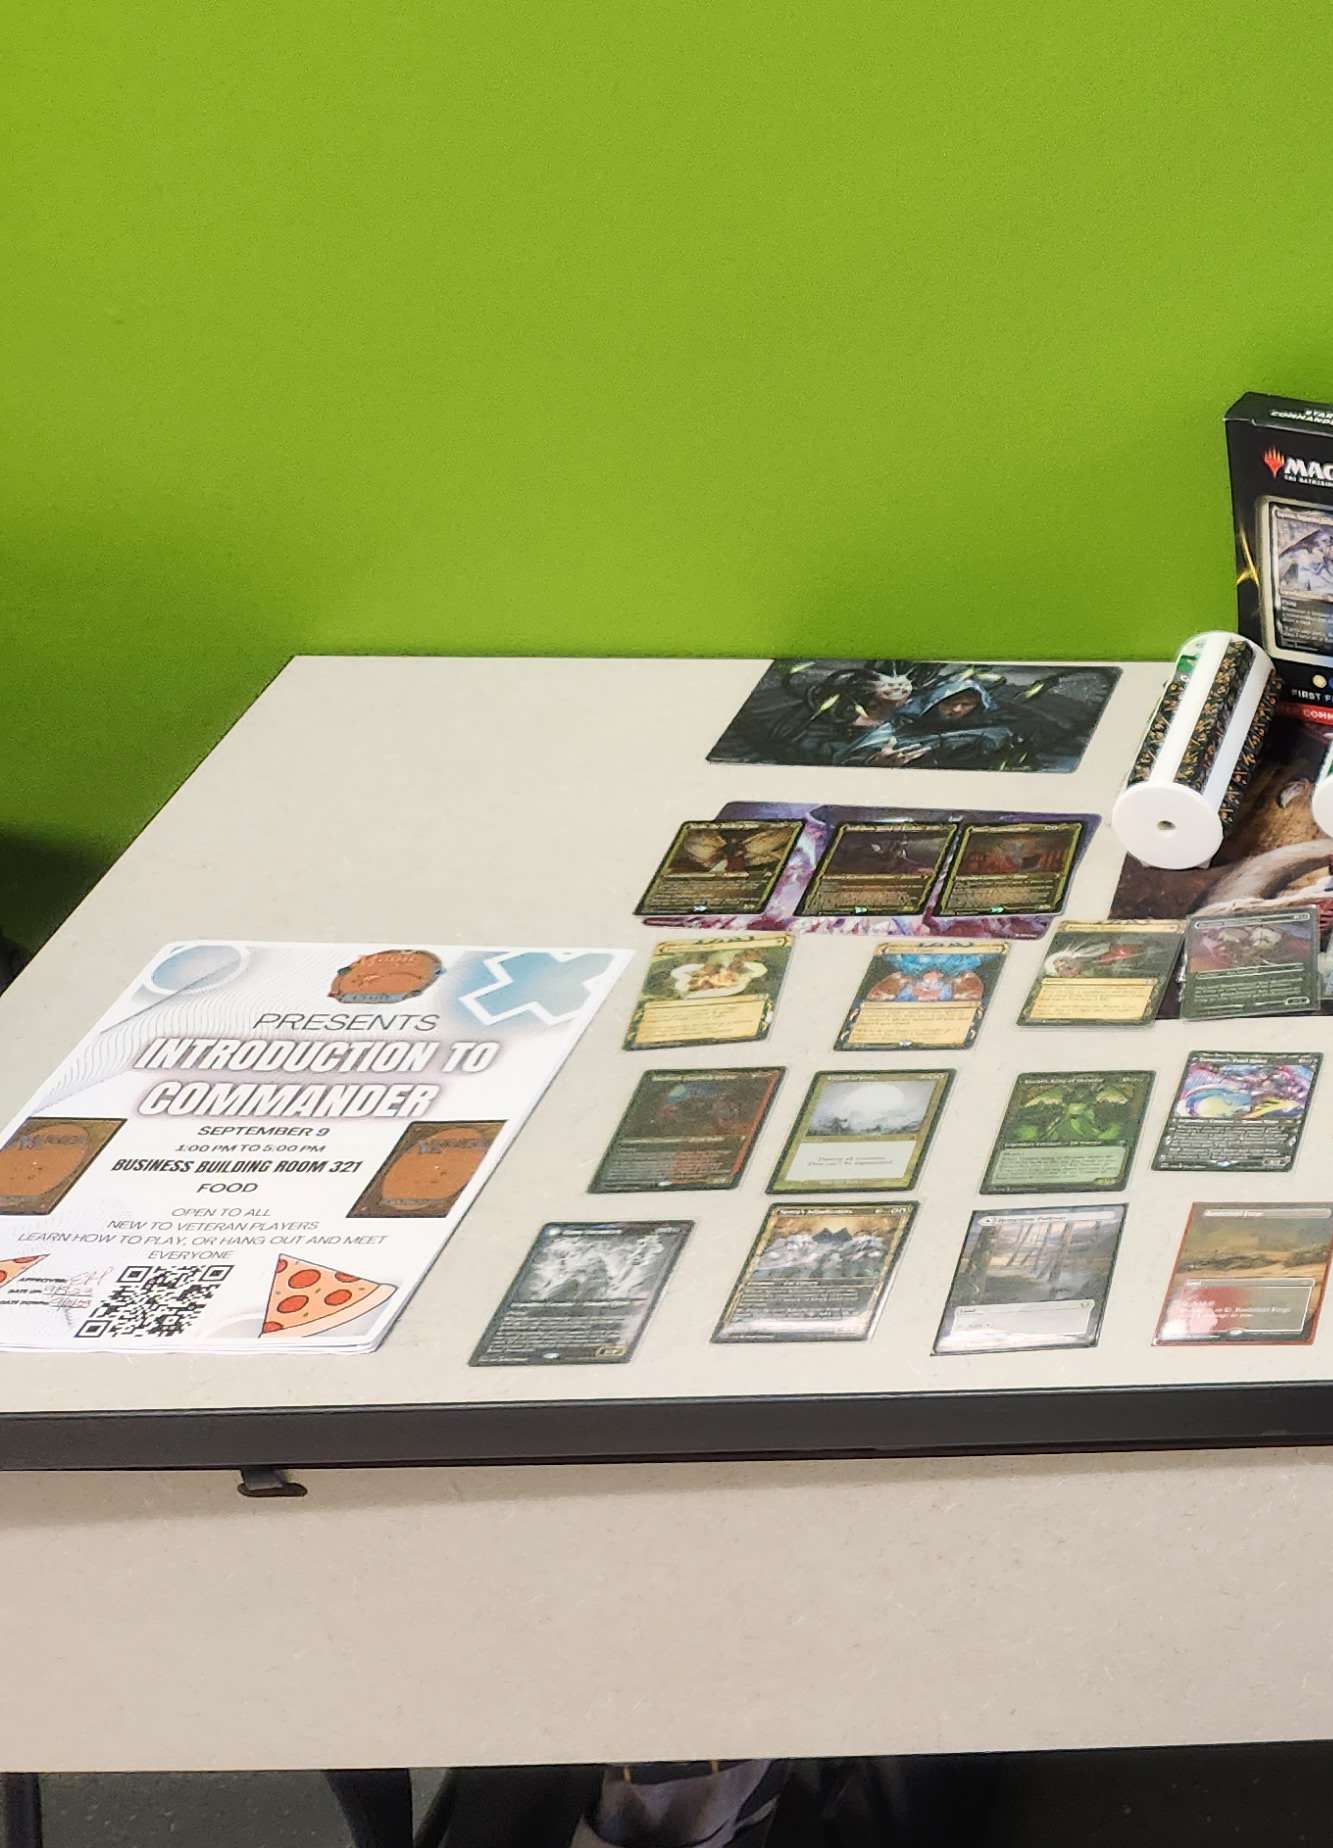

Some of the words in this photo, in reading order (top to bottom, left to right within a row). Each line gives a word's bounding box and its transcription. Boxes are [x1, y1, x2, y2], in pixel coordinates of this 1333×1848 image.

[1291, 688, 1322, 700] FIRST
[253, 1013, 441, 1032] PRESENTS
[133, 1036, 441, 1074] INTRODUCTION
[442, 1041, 503, 1074] TO
[136, 1080, 443, 1119] COMMANDER
[197, 1125, 311, 1137] SEPTEMBER
[315, 1127, 331, 1138] 9
[213, 1144, 238, 1153] PM
[239, 1144, 262, 1153] TO
[299, 1145, 327, 1153] PM
[111, 1158, 194, 1173] BUSINESS
[194, 1160, 272, 1174] BUILDING
[273, 1160, 329, 1174] ROOM
[328, 1161, 363, 1173] 321
[196, 1183, 259, 1194] FOOD
[171, 1208, 217, 1217] OPEN
[219, 1208, 242, 1217] TO
[243, 1208, 272, 1217] ALL
[106, 1220, 148, 1230] NEW
[150, 1221, 173, 1231] TO
[176, 1221, 248, 1231] VETERAN
[248, 1221, 320, 1231] PLAYERS
[17, 1232, 73, 1242] LEARN
[70, 1233, 118, 1243] HOW
[119, 1234, 144, 1244] TO
[190, 1236, 218, 1246] OR
[218, 1236, 267, 1246] HANG
[269, 1235, 306, 1245] OUT
[304, 1235, 343, 1245] AND
[342, 1235, 390, 1245] MEET
[148, 1250, 235, 1260] EVERYONE
